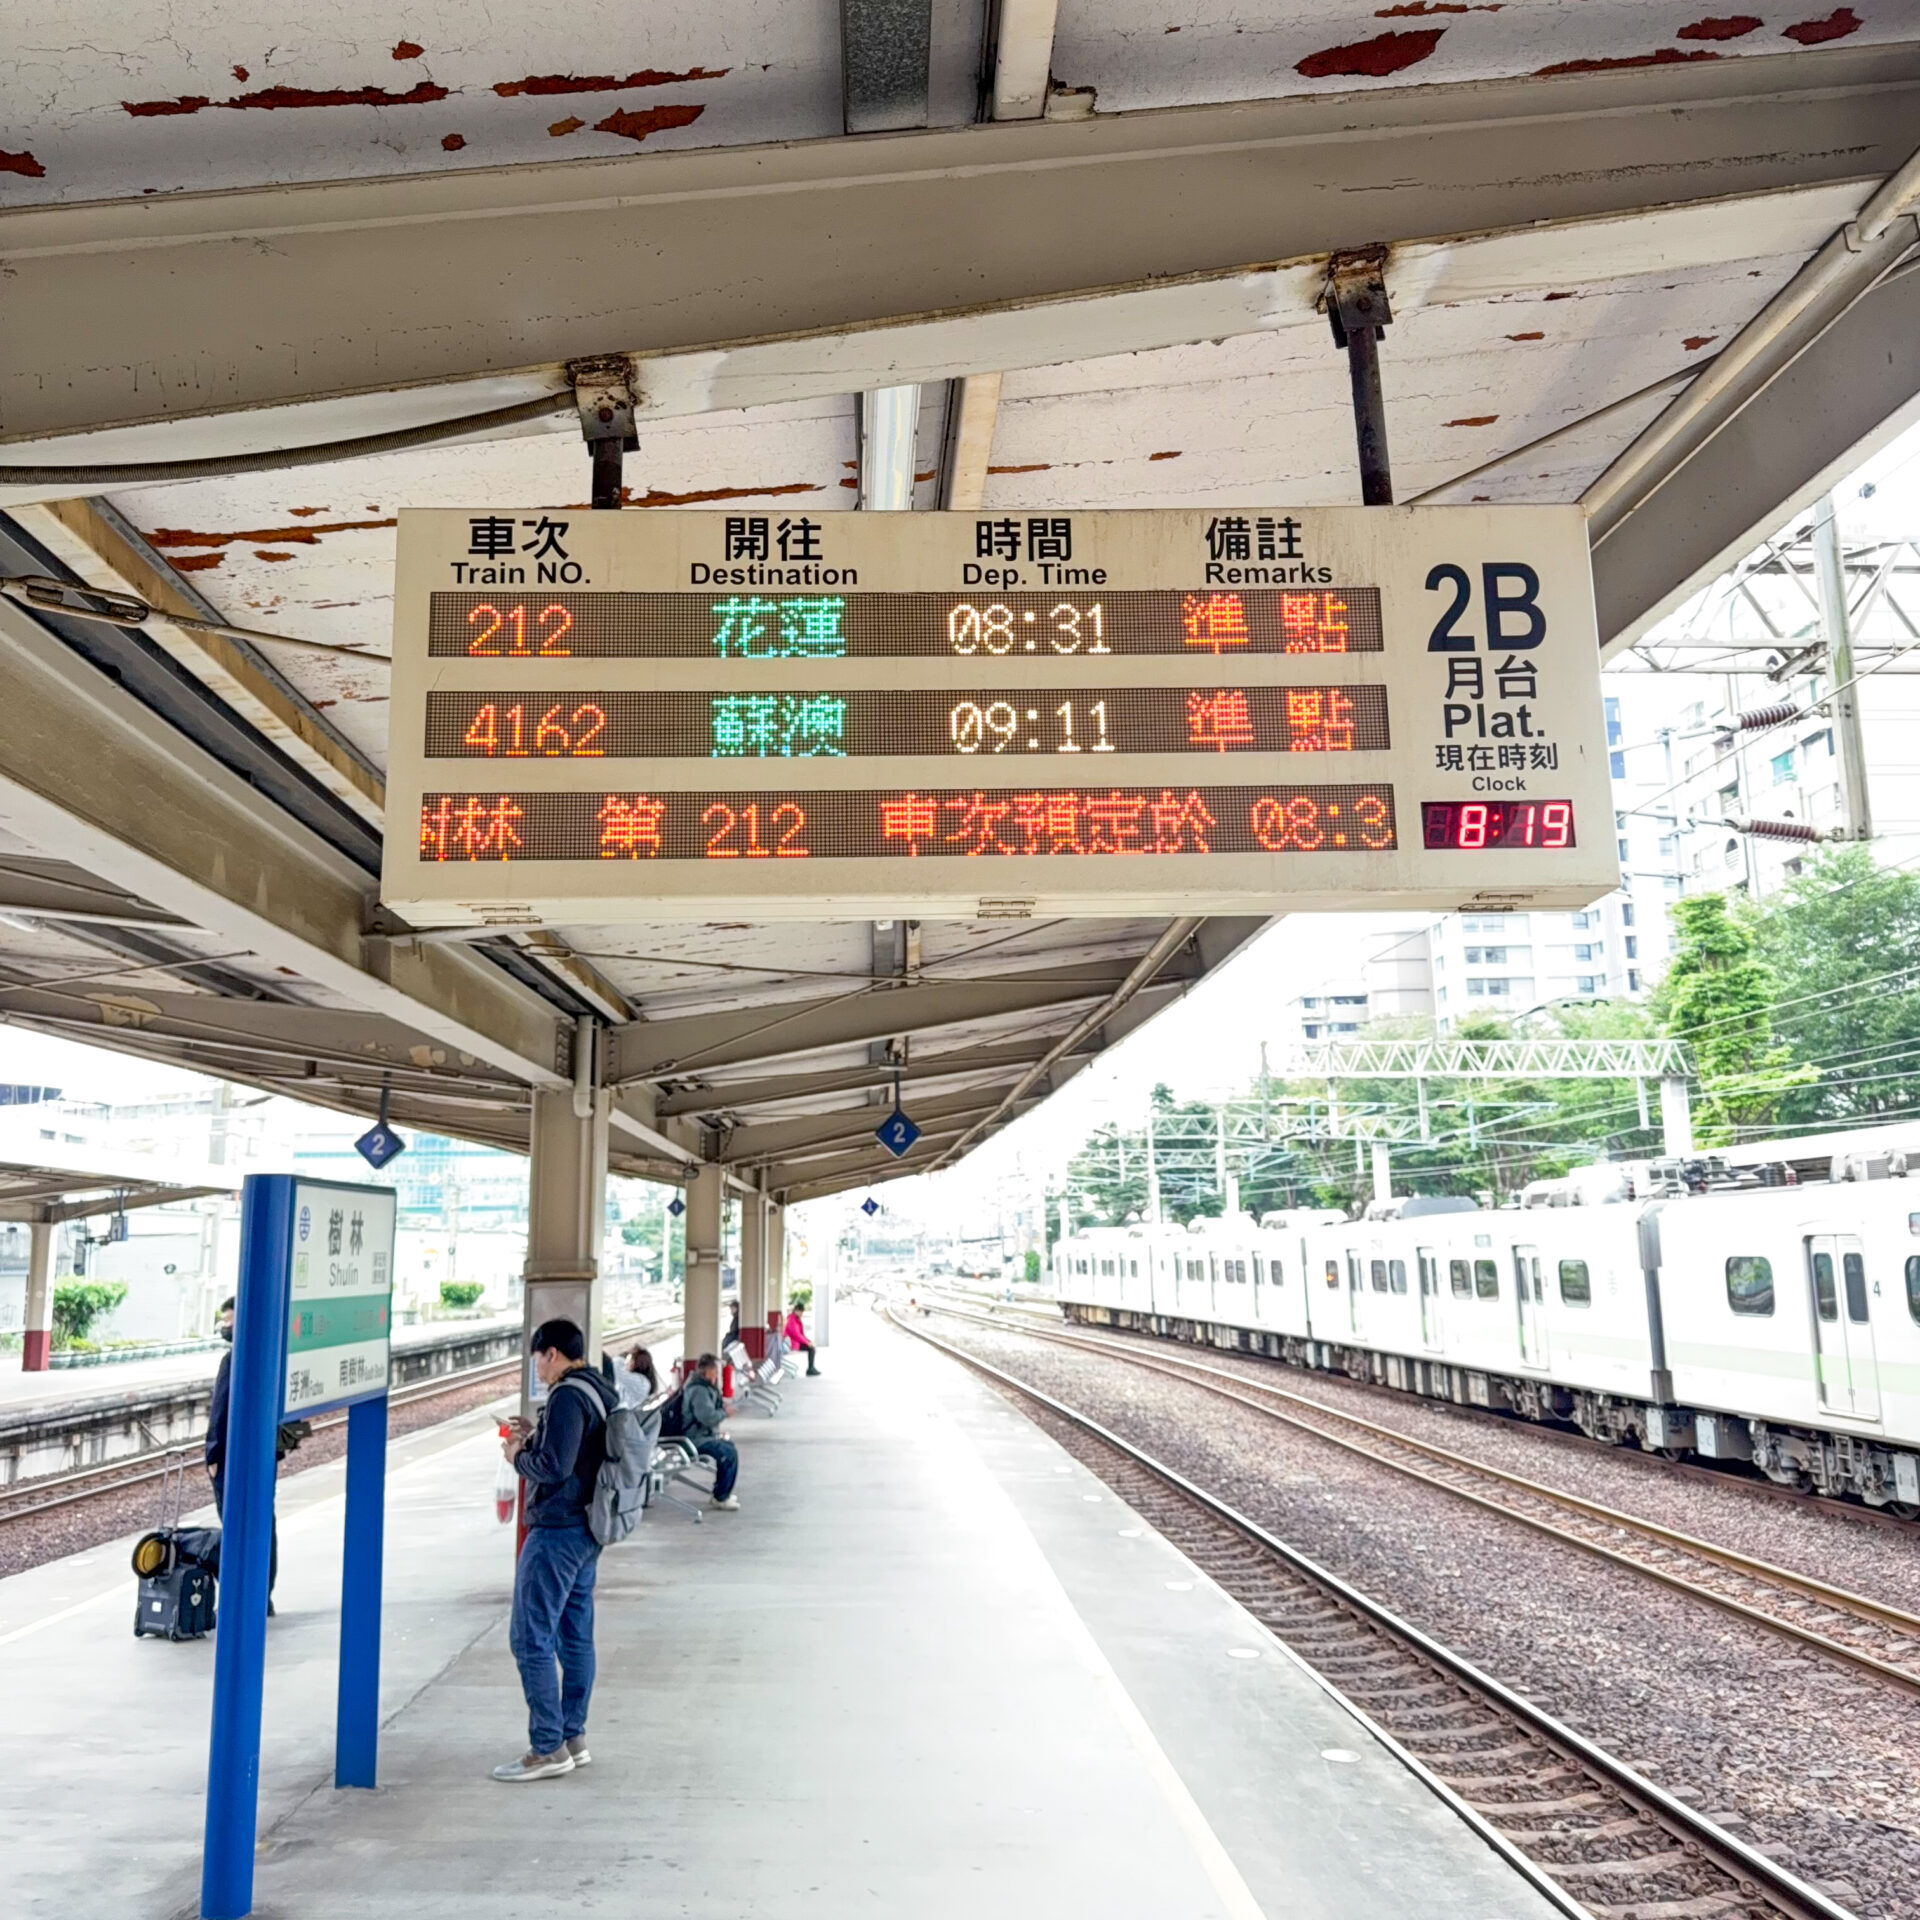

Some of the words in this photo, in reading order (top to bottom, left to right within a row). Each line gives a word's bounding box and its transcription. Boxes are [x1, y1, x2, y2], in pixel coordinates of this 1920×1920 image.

[468, 516, 570, 560] 車次
[725, 517, 823, 562] 開往
[976, 518, 1072, 563] 時間
[1205, 517, 1304, 562] 備註
[451, 562, 526, 585] Train
[537, 562, 591, 585] NO.
[690, 562, 858, 586] Destination
[963, 563, 1027, 590] Dep.
[1037, 563, 1108, 585] Time
[1205, 562, 1333, 584] Remarks
[711, 597, 846, 658] 花蓮
[948, 603, 1111, 654] 08:31
[1424, 561, 1547, 653] 2B
[467, 604, 572, 656] 212
[1444, 655, 1539, 700] 月台
[464, 704, 605, 756] 4162
[711, 695, 847, 758] 蘇澳
[950, 701, 1115, 754] 09:11
[1443, 704, 1546, 739] Plat.
[1435, 743, 1558, 772] 現在時刻
[1472, 776, 1527, 792] Clock
[702, 803, 809, 857] 212
[1458, 804, 1571, 848] 8:19
[371, 1133, 386, 1156] 2
[892, 1121, 906, 1144] 2
[328, 1208, 364, 1256] 樹林
[329, 1261, 359, 1287] Shulin
[1873, 1280, 1881, 1298] 4
